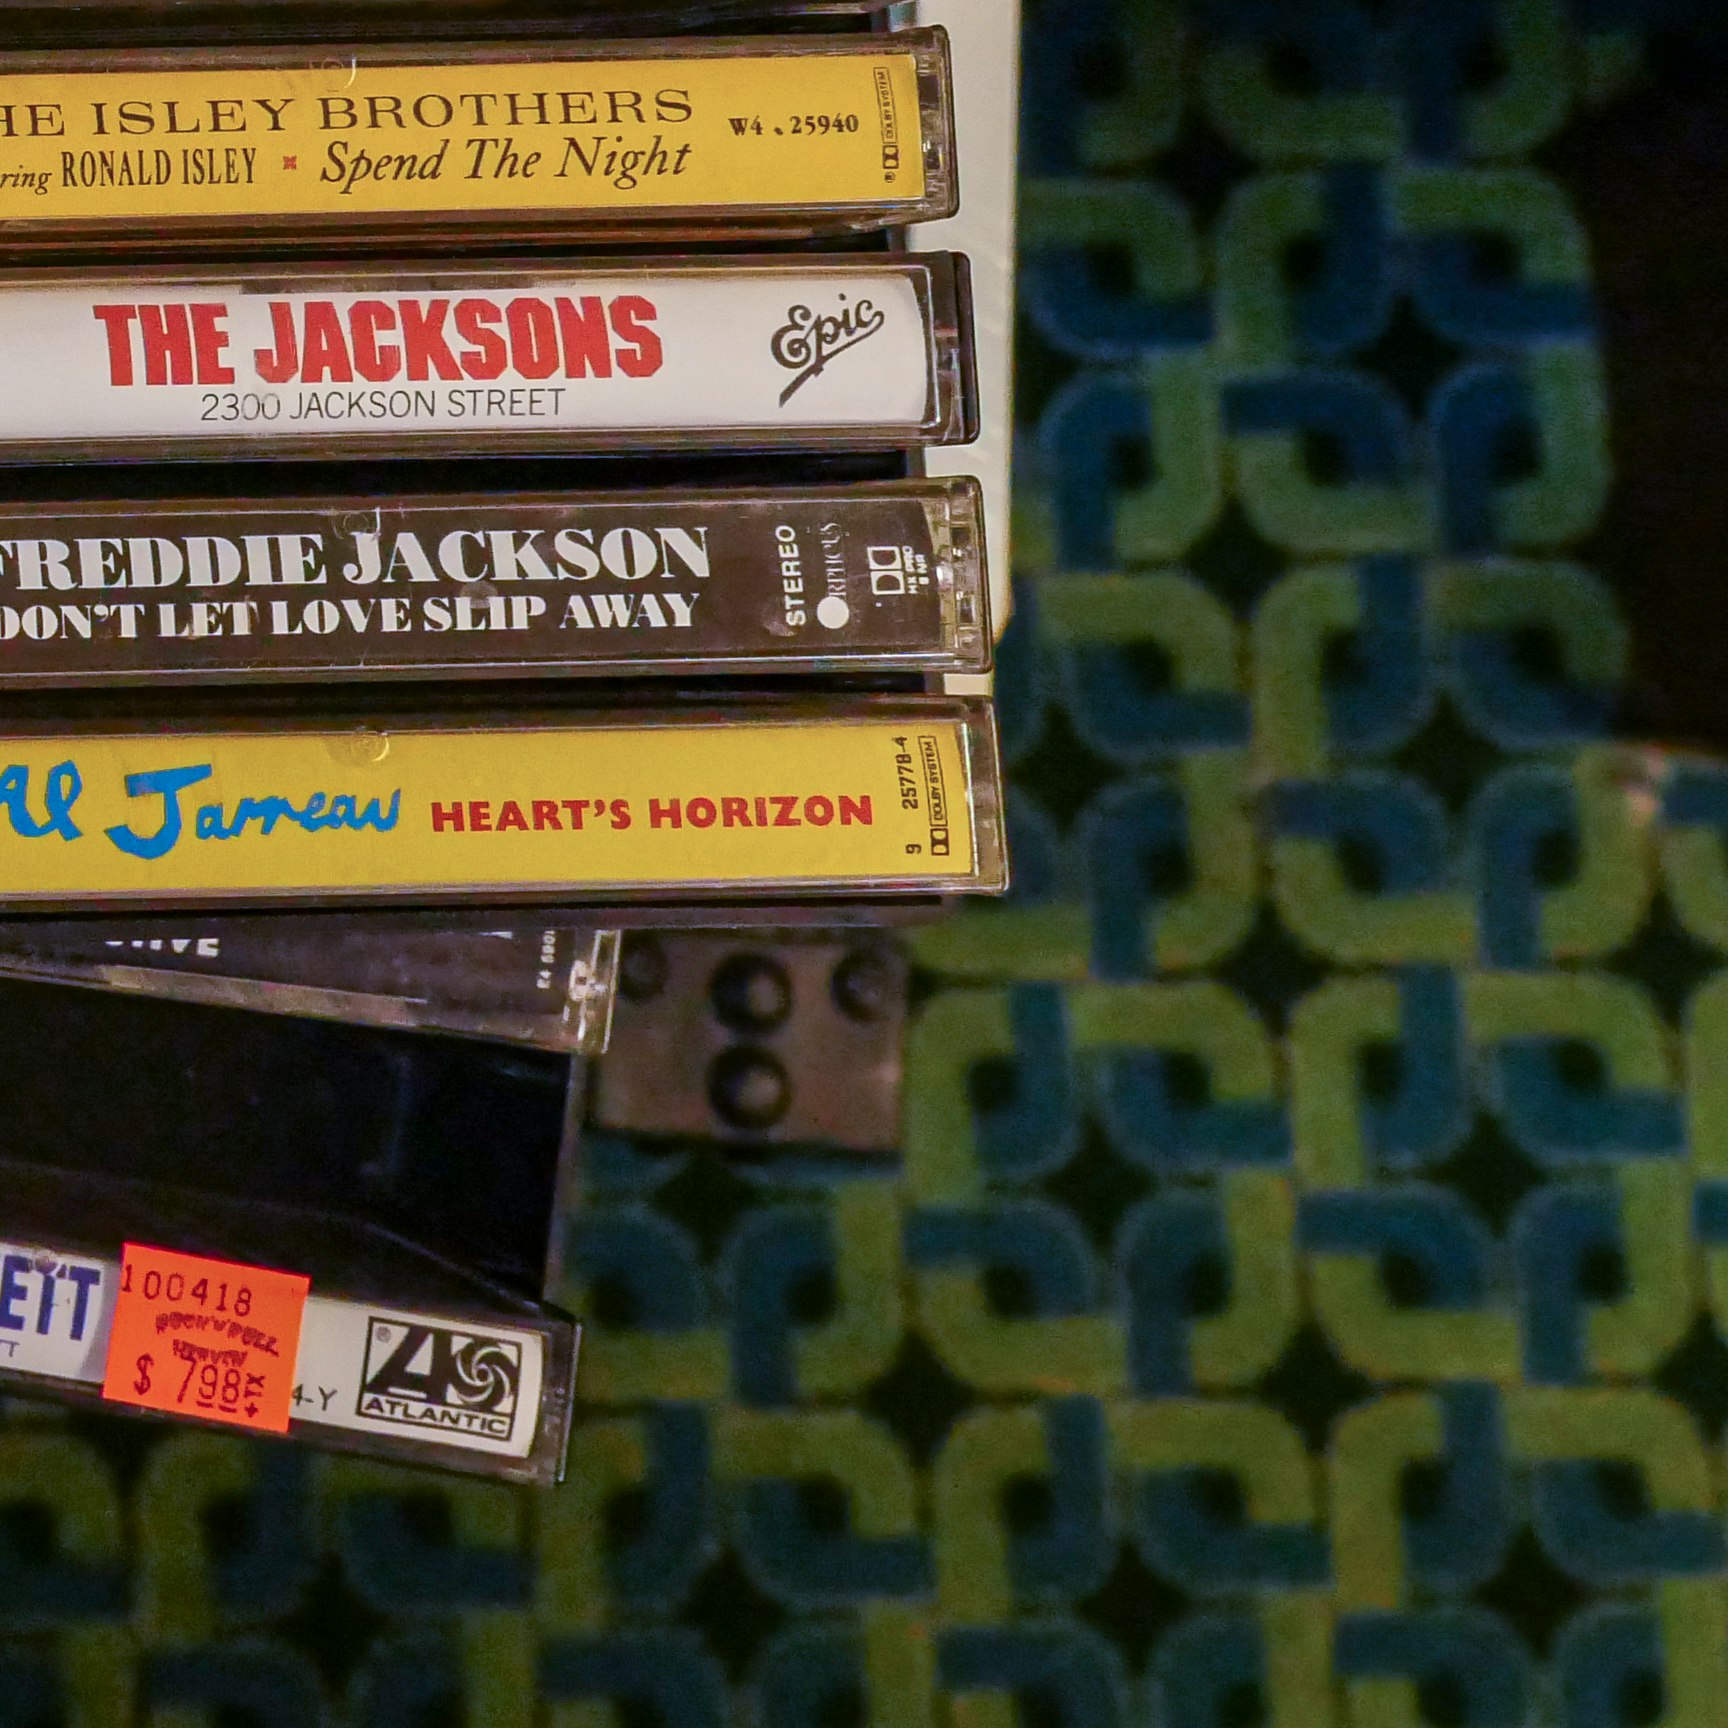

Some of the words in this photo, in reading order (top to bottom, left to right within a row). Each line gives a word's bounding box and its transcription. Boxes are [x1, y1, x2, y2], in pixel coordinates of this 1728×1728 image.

[93, 98, 297, 136] ISLEY
[316, 89, 693, 131] BROTHERS
[93, 302, 235, 387] THE
[254, 296, 663, 385] JACKSONS
[344, 526, 711, 586] JACKSON
[775, 524, 806, 628] STEREO
[431, 798, 630, 833] HEART'S
[649, 794, 875, 830] HORIZON
